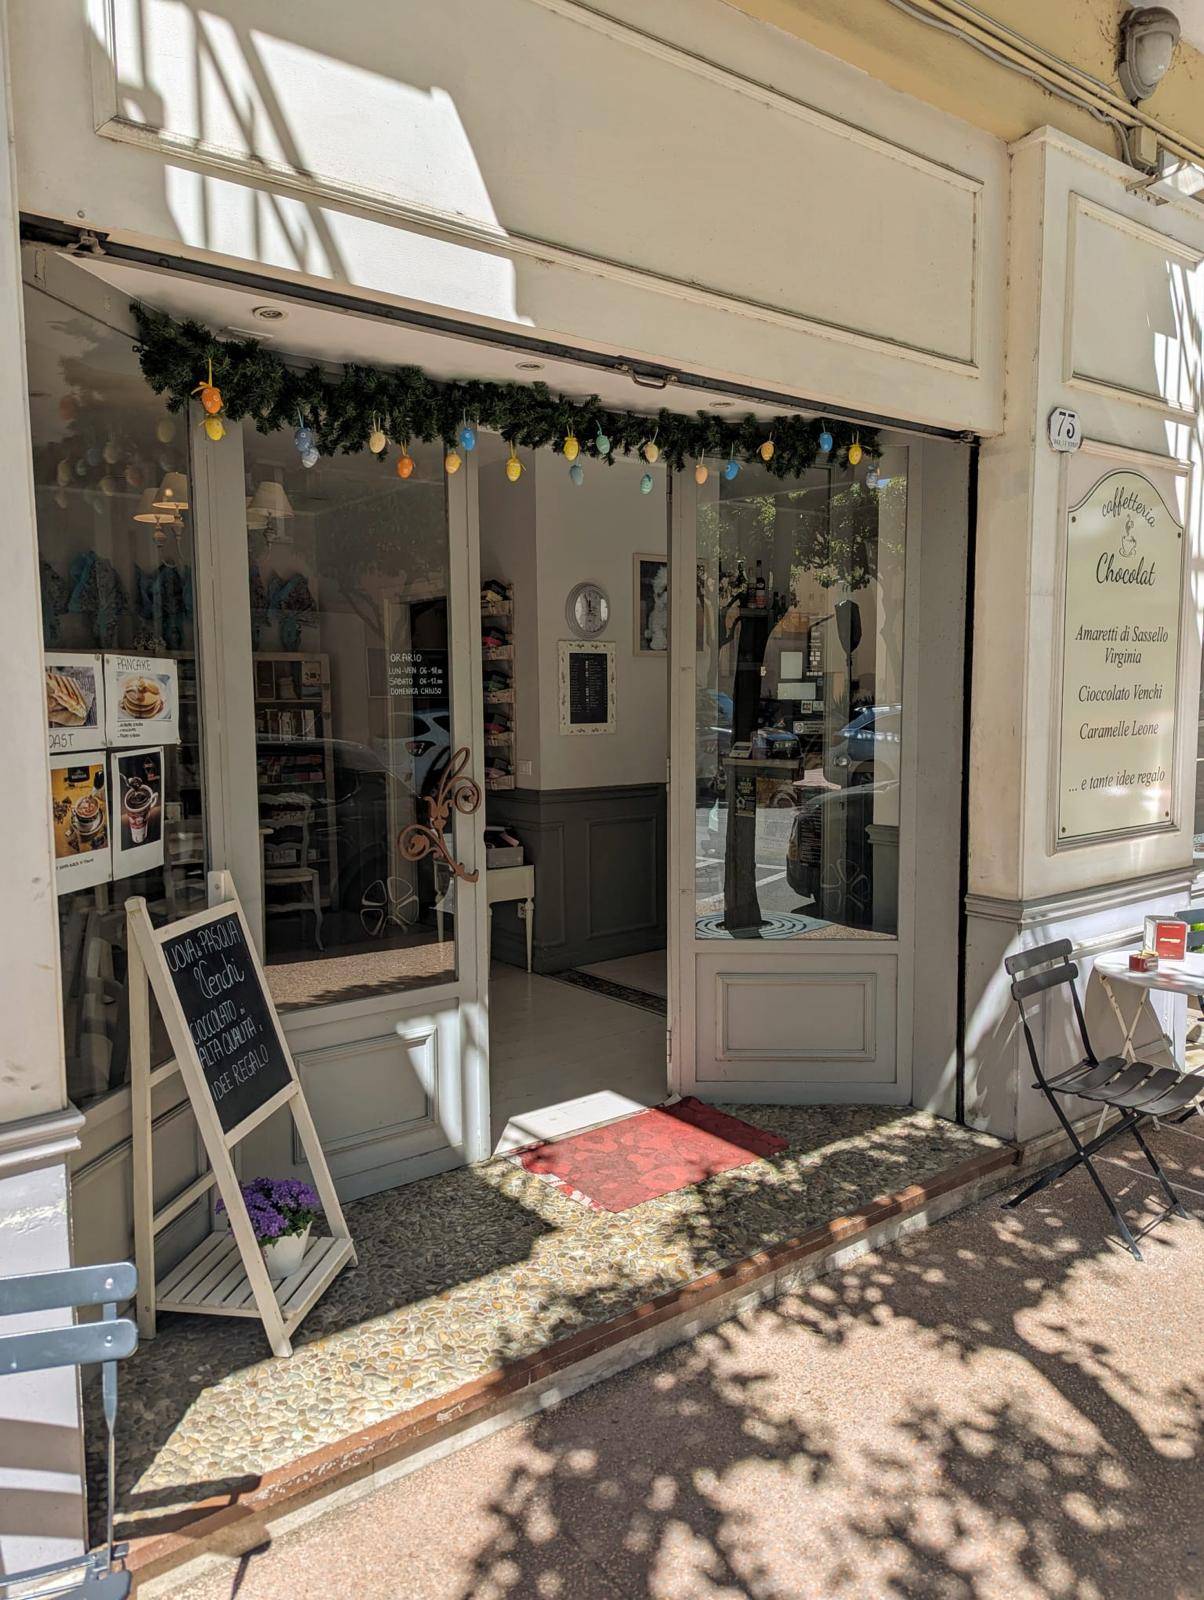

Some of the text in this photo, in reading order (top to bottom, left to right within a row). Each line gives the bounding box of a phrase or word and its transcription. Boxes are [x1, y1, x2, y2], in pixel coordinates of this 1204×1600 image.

[1102, 487, 1155, 527] caffetteria
[1096, 552, 1155, 586] Chocolat
[1075, 624, 1169, 643] Amaretti di Sassello
[117, 657, 152, 671] PANCAKE
[390, 651, 422, 662] ORARIO
[1104, 647, 1142, 668] Virginia
[420, 687, 442, 695] CHIUSO
[1078, 684, 1163, 703] Cioccolato Venchi
[1079, 720, 1159, 740] Caramelle Leone
[1089, 772, 1113, 790] tante
[1115, 769, 1134, 786] idee
[1137, 766, 1165, 788] regalo
[165, 920, 241, 972] UOVA PASQUA
[193, 953, 245, 999] Venchi
[190, 999, 237, 1045] CIOCCOLATO
[199, 1038, 225, 1068] ALTA
[211, 1044, 269, 1101] IDEE REGALO
